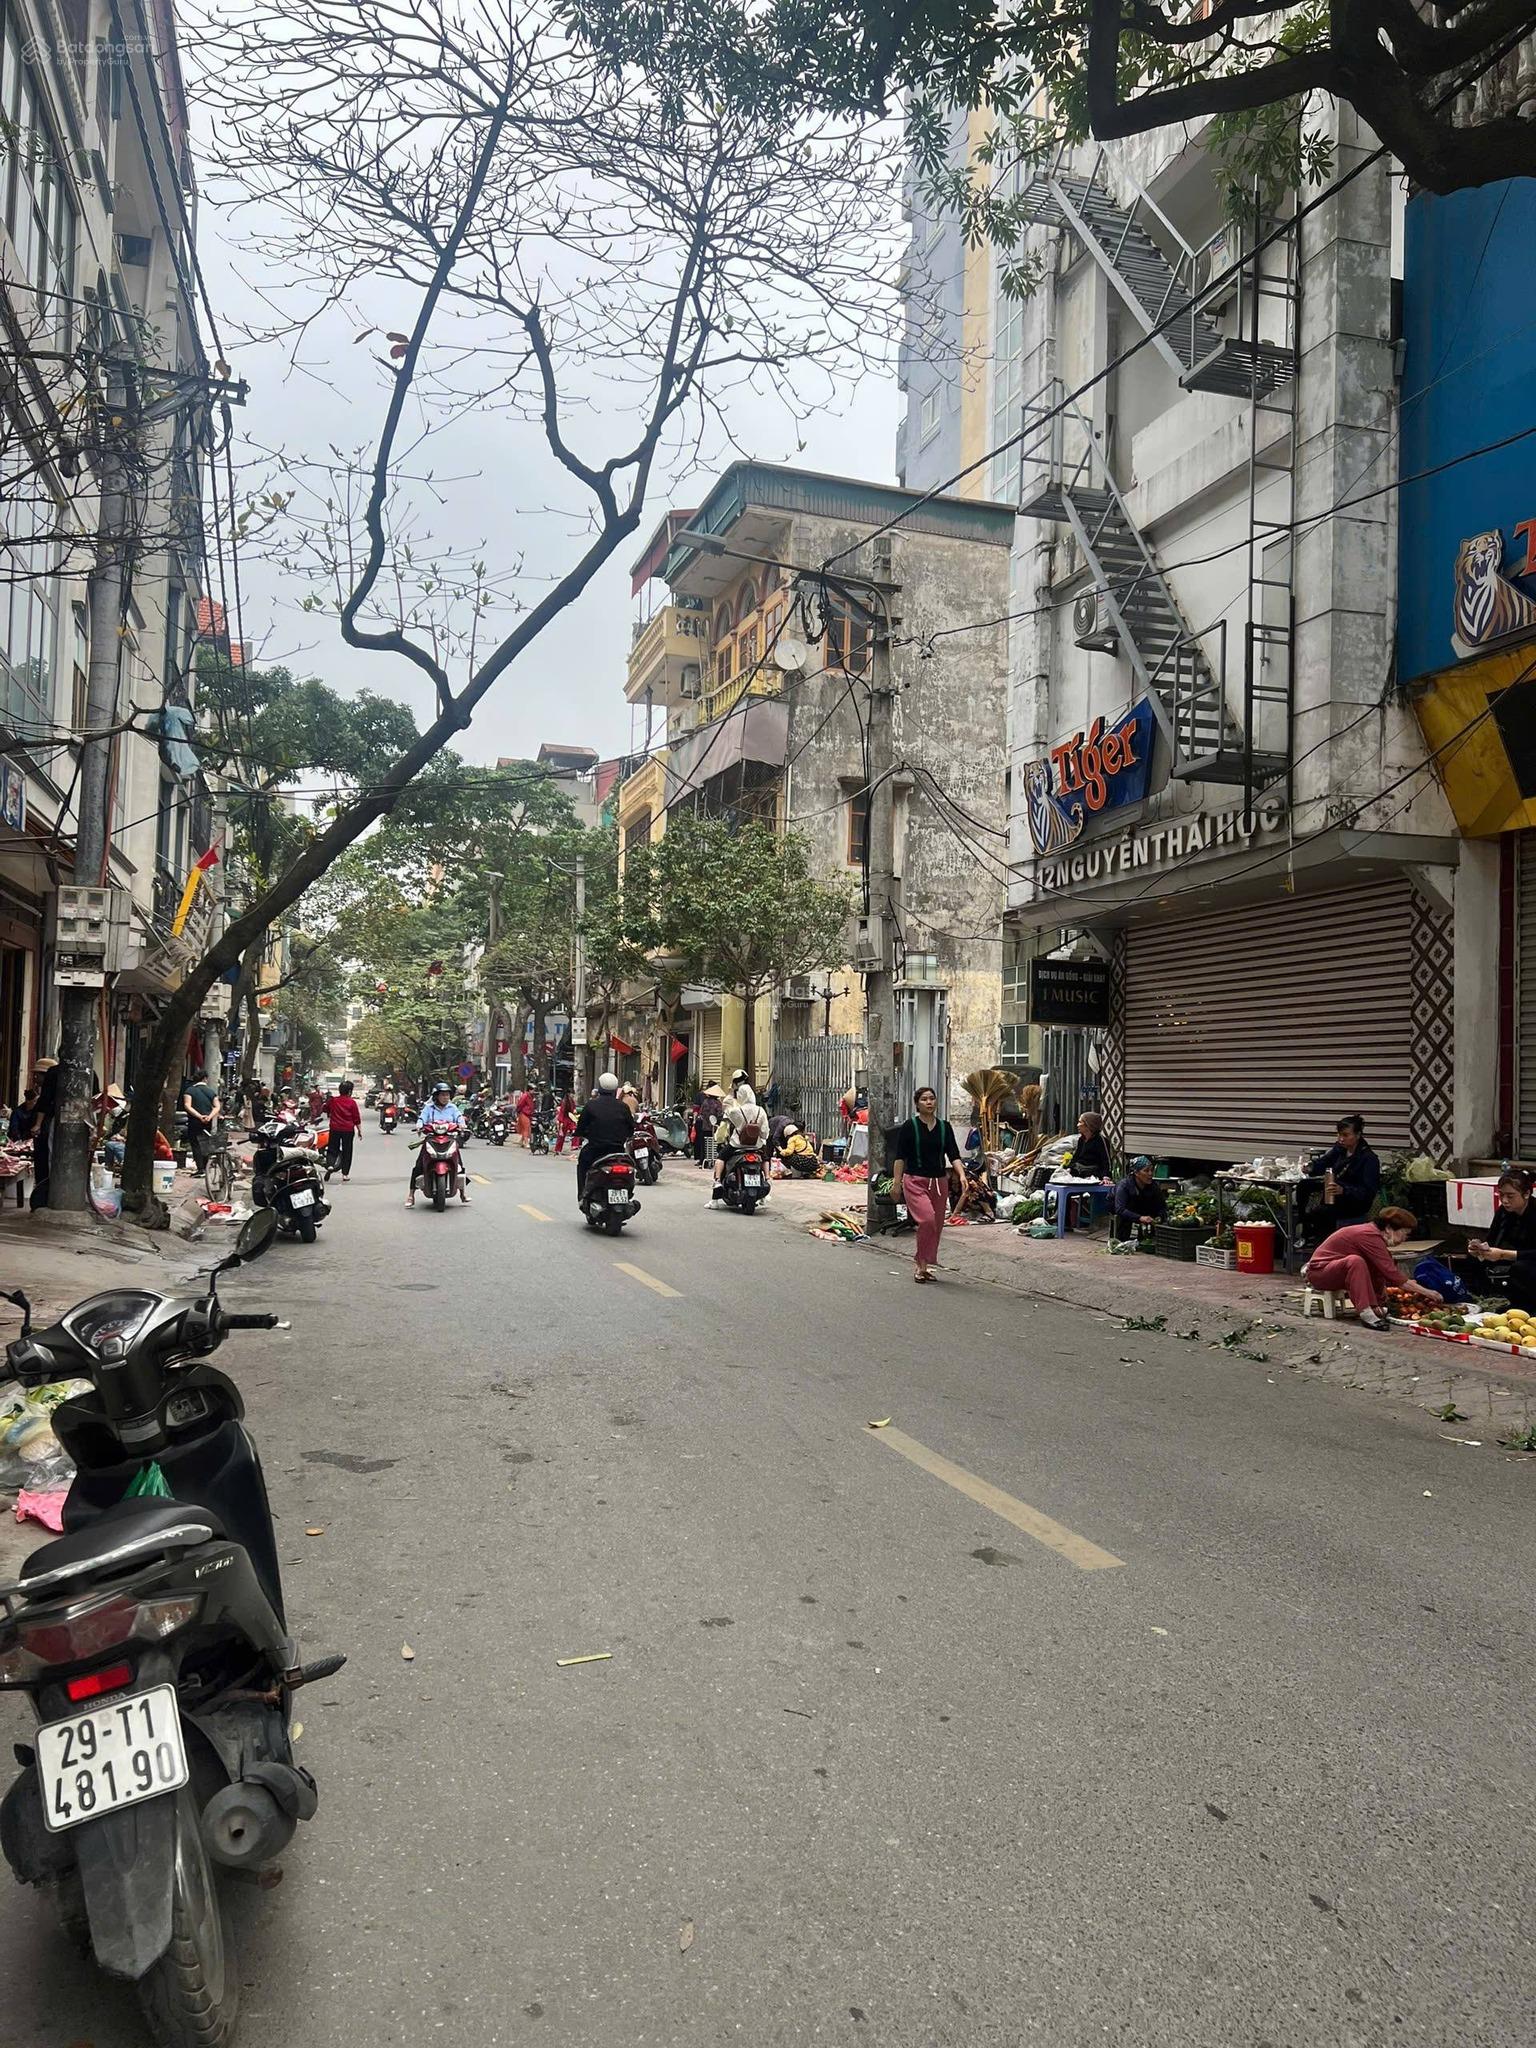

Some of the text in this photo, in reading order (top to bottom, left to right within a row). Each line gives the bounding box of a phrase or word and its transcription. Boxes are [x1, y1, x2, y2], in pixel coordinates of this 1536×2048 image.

[1051, 716, 1138, 811] Tiger
[1051, 987, 1098, 1004] MUSIC
[57, 1698, 154, 1769] 29-T1
[83, 1691, 127, 1710] HONDA
[54, 1741, 176, 1818] 481.90
